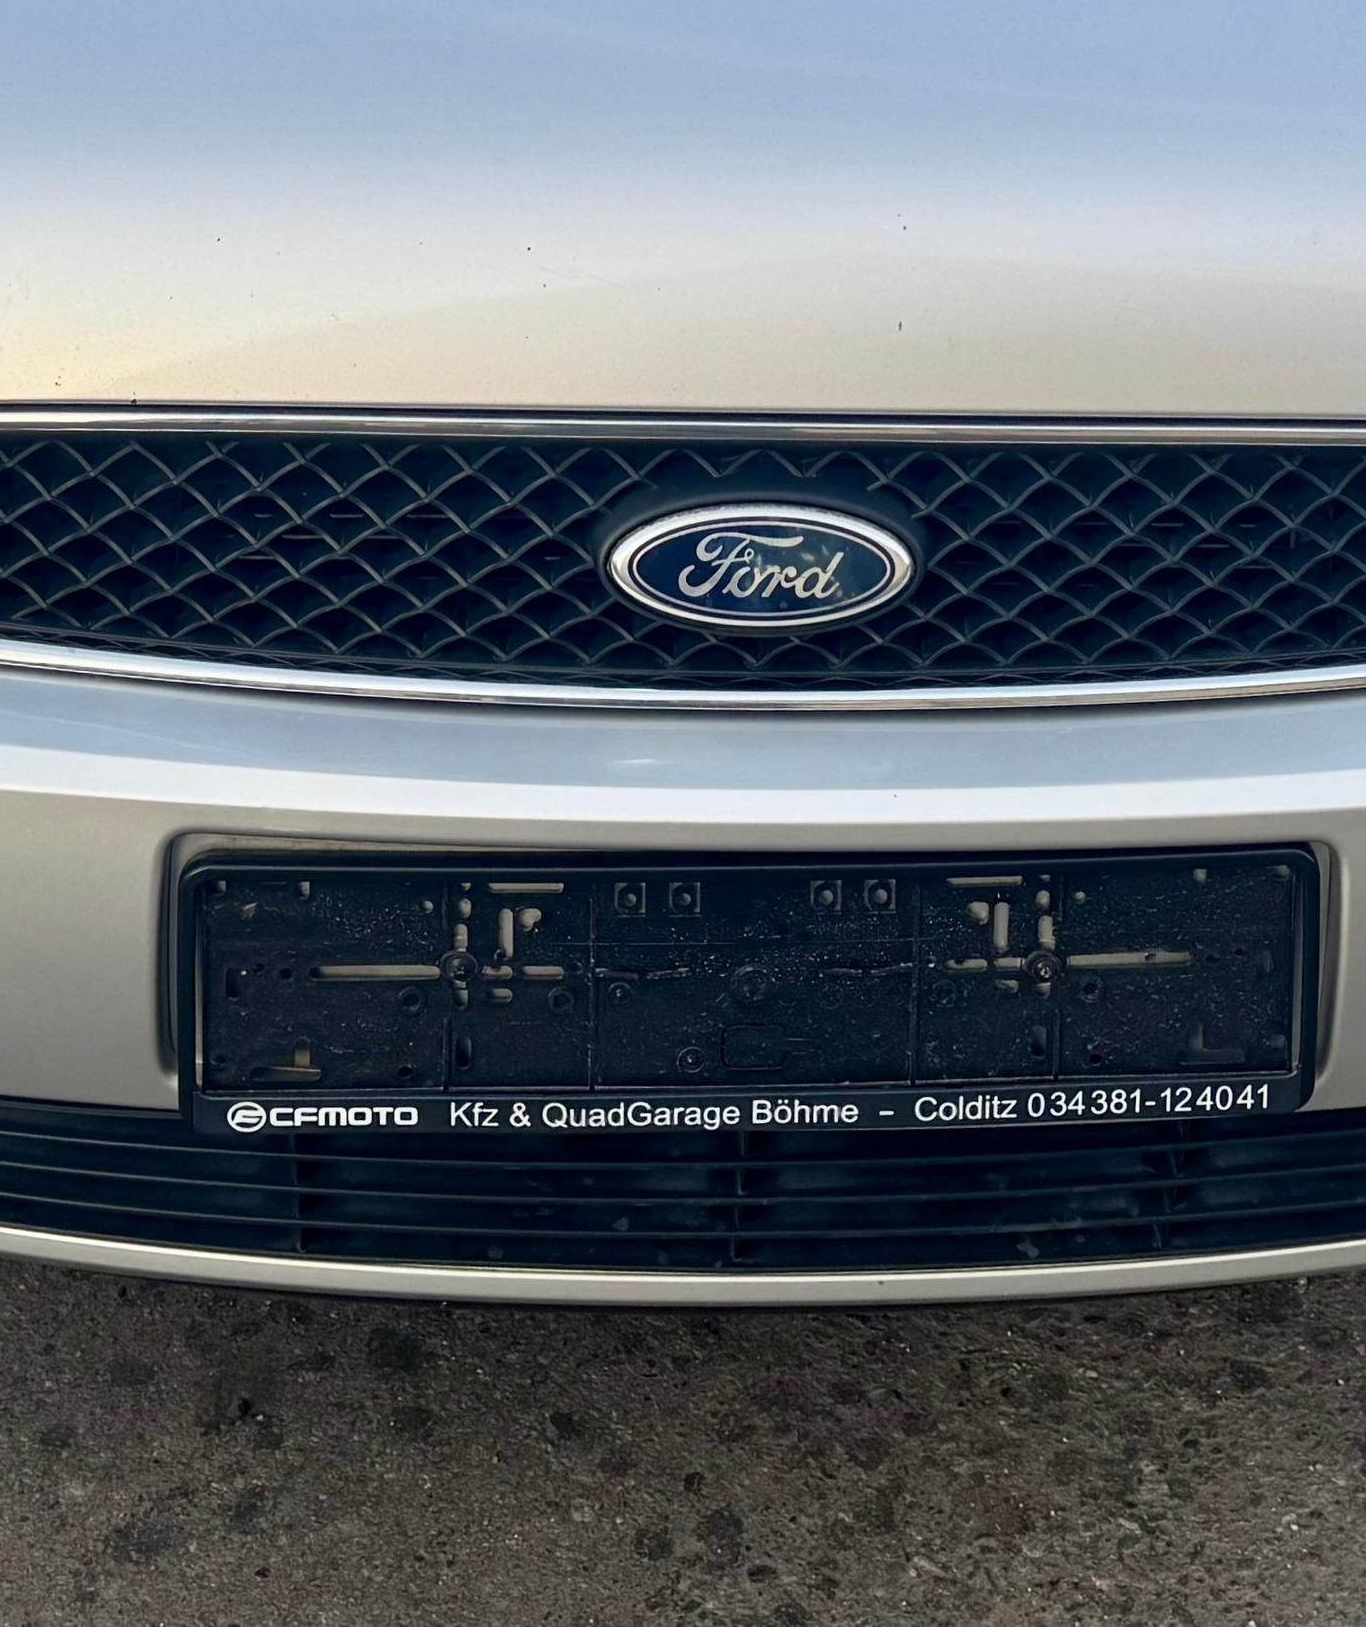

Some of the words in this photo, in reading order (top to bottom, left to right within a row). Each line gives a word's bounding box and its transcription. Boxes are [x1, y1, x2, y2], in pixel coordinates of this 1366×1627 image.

[678, 532, 845, 599] Ford
[269, 1105, 419, 1127] CFMOTO
[449, 1101, 499, 1127] Kfz
[509, 1102, 532, 1127] &
[542, 1100, 741, 1132] QuadGarage
[750, 1098, 859, 1125] Böhme
[914, 1094, 1018, 1122] Colditz
